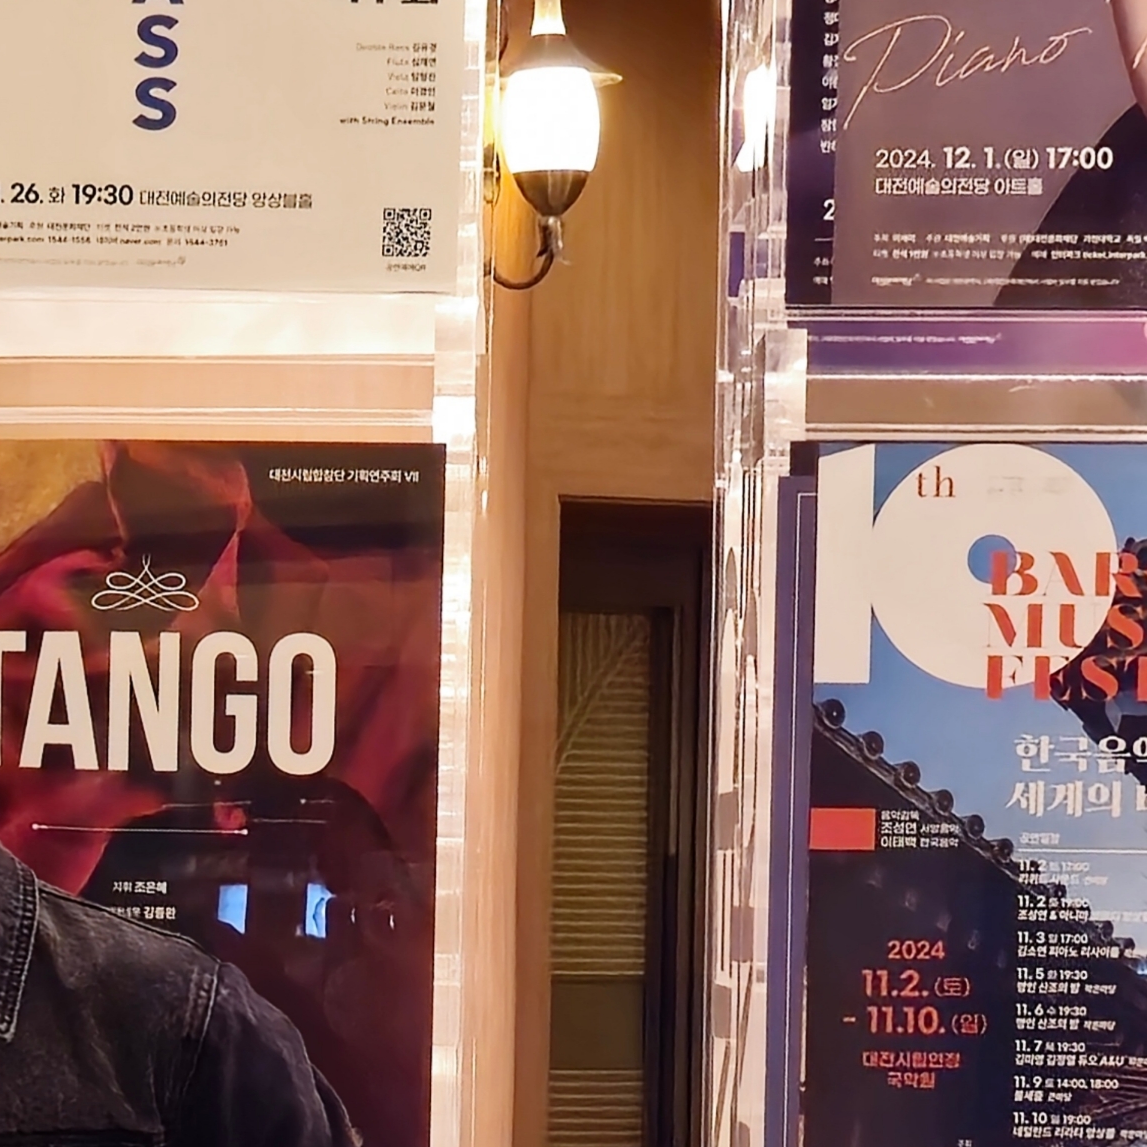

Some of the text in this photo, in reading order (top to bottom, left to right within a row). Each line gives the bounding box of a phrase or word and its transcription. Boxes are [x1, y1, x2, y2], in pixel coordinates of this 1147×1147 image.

[843, 14, 1092, 130] Piano
[362, 116, 389, 127] String
[391, 116, 435, 126] Ensemble
[875, 149, 936, 170] 2024.
[943, 146, 976, 169] 12.
[1046, 146, 1114, 169] 17:00
[874, 177, 1043, 196] 대전예술의전당 아트홀
[10, 182, 44, 204] 26.
[48, 187, 66, 204] 화
[71, 184, 134, 206] 19:30
[139, 190, 247, 208] 대전예술의전당
[252, 192, 313, 210] 앙상블홀
[269, 468, 345, 483] 대전시립합창단
[915, 465, 956, 499] th
[1005, 779, 1121, 819] 세계의
[880, 836, 917, 848] 이태백
[1018, 859, 1035, 872] 11.
[1037, 859, 1047, 872] 2
[112, 881, 132, 893] 지휘
[1017, 895, 1034, 908] 11.
[1036, 896, 1047, 908] 2
[1017, 931, 1033, 944] 11.
[1036, 931, 1045, 944] 3
[1060, 933, 1089, 945] 17:00
[887, 940, 945, 960] 2024
[1049, 946, 1079, 958] 피아노
[1016, 968, 1033, 980] 11.
[1035, 968, 1044, 980] 5
[1059, 969, 1088, 980] 19:30
[861, 969, 971, 997] 11.2. (토)
[1016, 1003, 1032, 1016] 11.
[1034, 1003, 1044, 1016] 6
[1058, 1006, 1087, 1016] 19:30
[866, 1006, 946, 1034] 11.10.
[951, 1013, 988, 1034] (일)
[1015, 1039, 1031, 1052] 11.
[1033, 1039, 1043, 1052] 7
[1057, 1042, 1086, 1052] 19:30
[862, 1051, 960, 1069] 대전시립연정
[887, 1071, 935, 1089] 국악원
[1014, 1076, 1030, 1088] 11.
[1032, 1076, 1042, 1088] 9
[1090, 1078, 1119, 1089] 18:00
[1013, 1112, 1029, 1124] 11.
[1032, 1112, 1047, 1124] 10
[1063, 1114, 1091, 1125] 19:00
